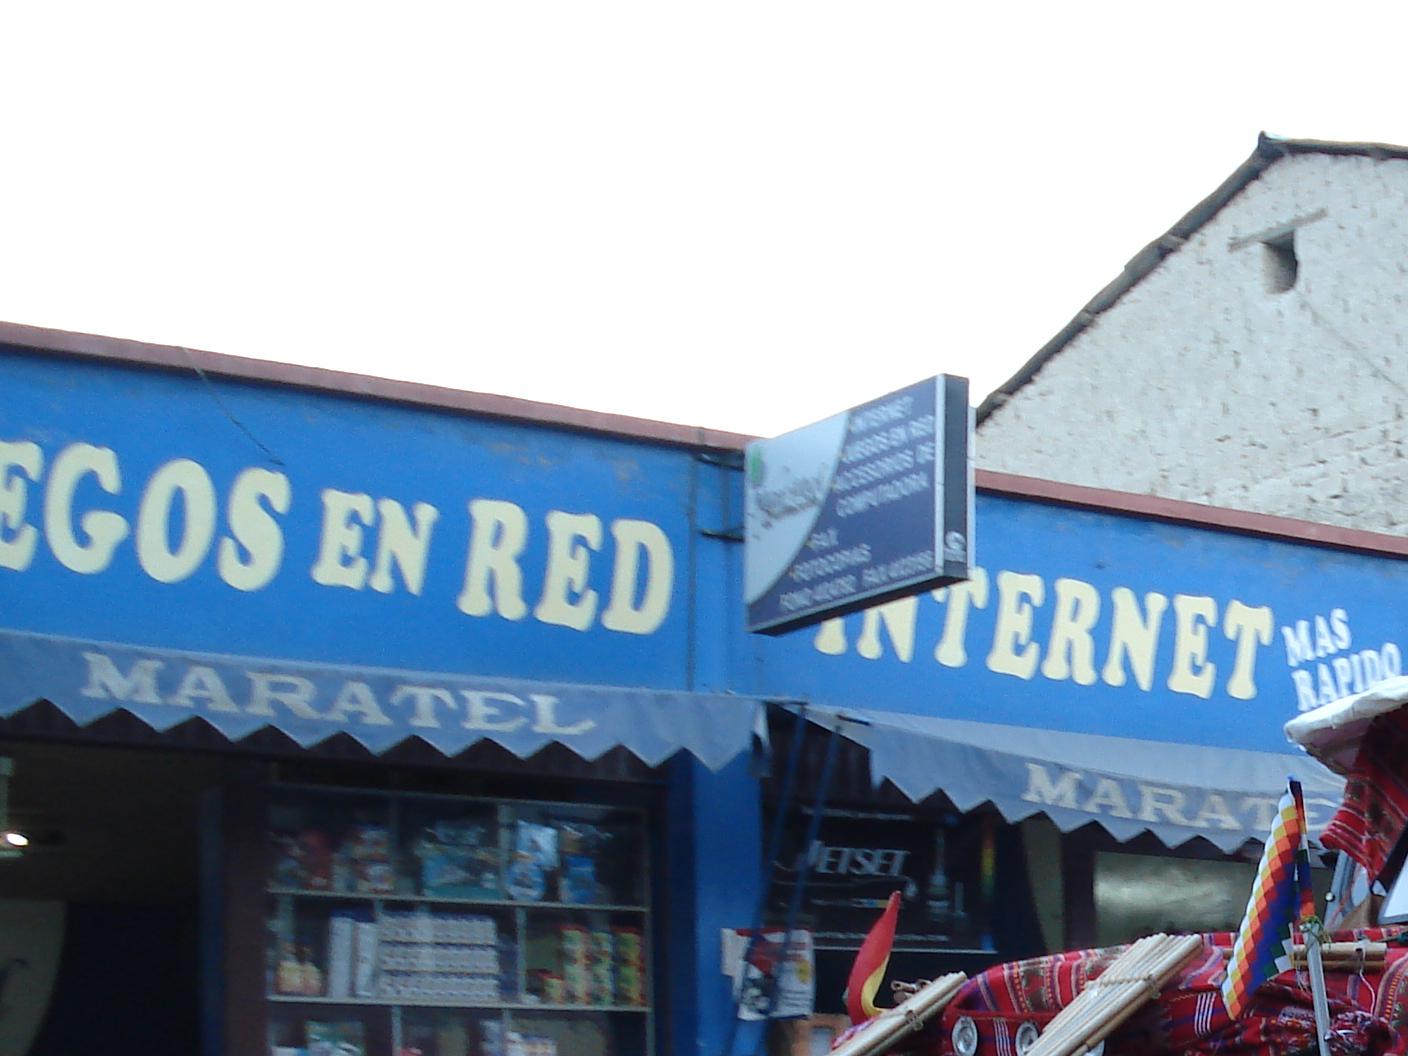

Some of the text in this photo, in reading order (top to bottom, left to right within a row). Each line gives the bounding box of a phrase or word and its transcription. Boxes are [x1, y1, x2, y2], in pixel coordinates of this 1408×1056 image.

[0, 441, 292, 592] EGOS
[312, 488, 439, 596] EN
[457, 498, 675, 635] RED
[1281, 607, 1352, 668] MAS
[79, 652, 597, 737] MARATEL
[1291, 641, 1403, 712] RAPIDO
[1021, 761, 1340, 831] MARATE
